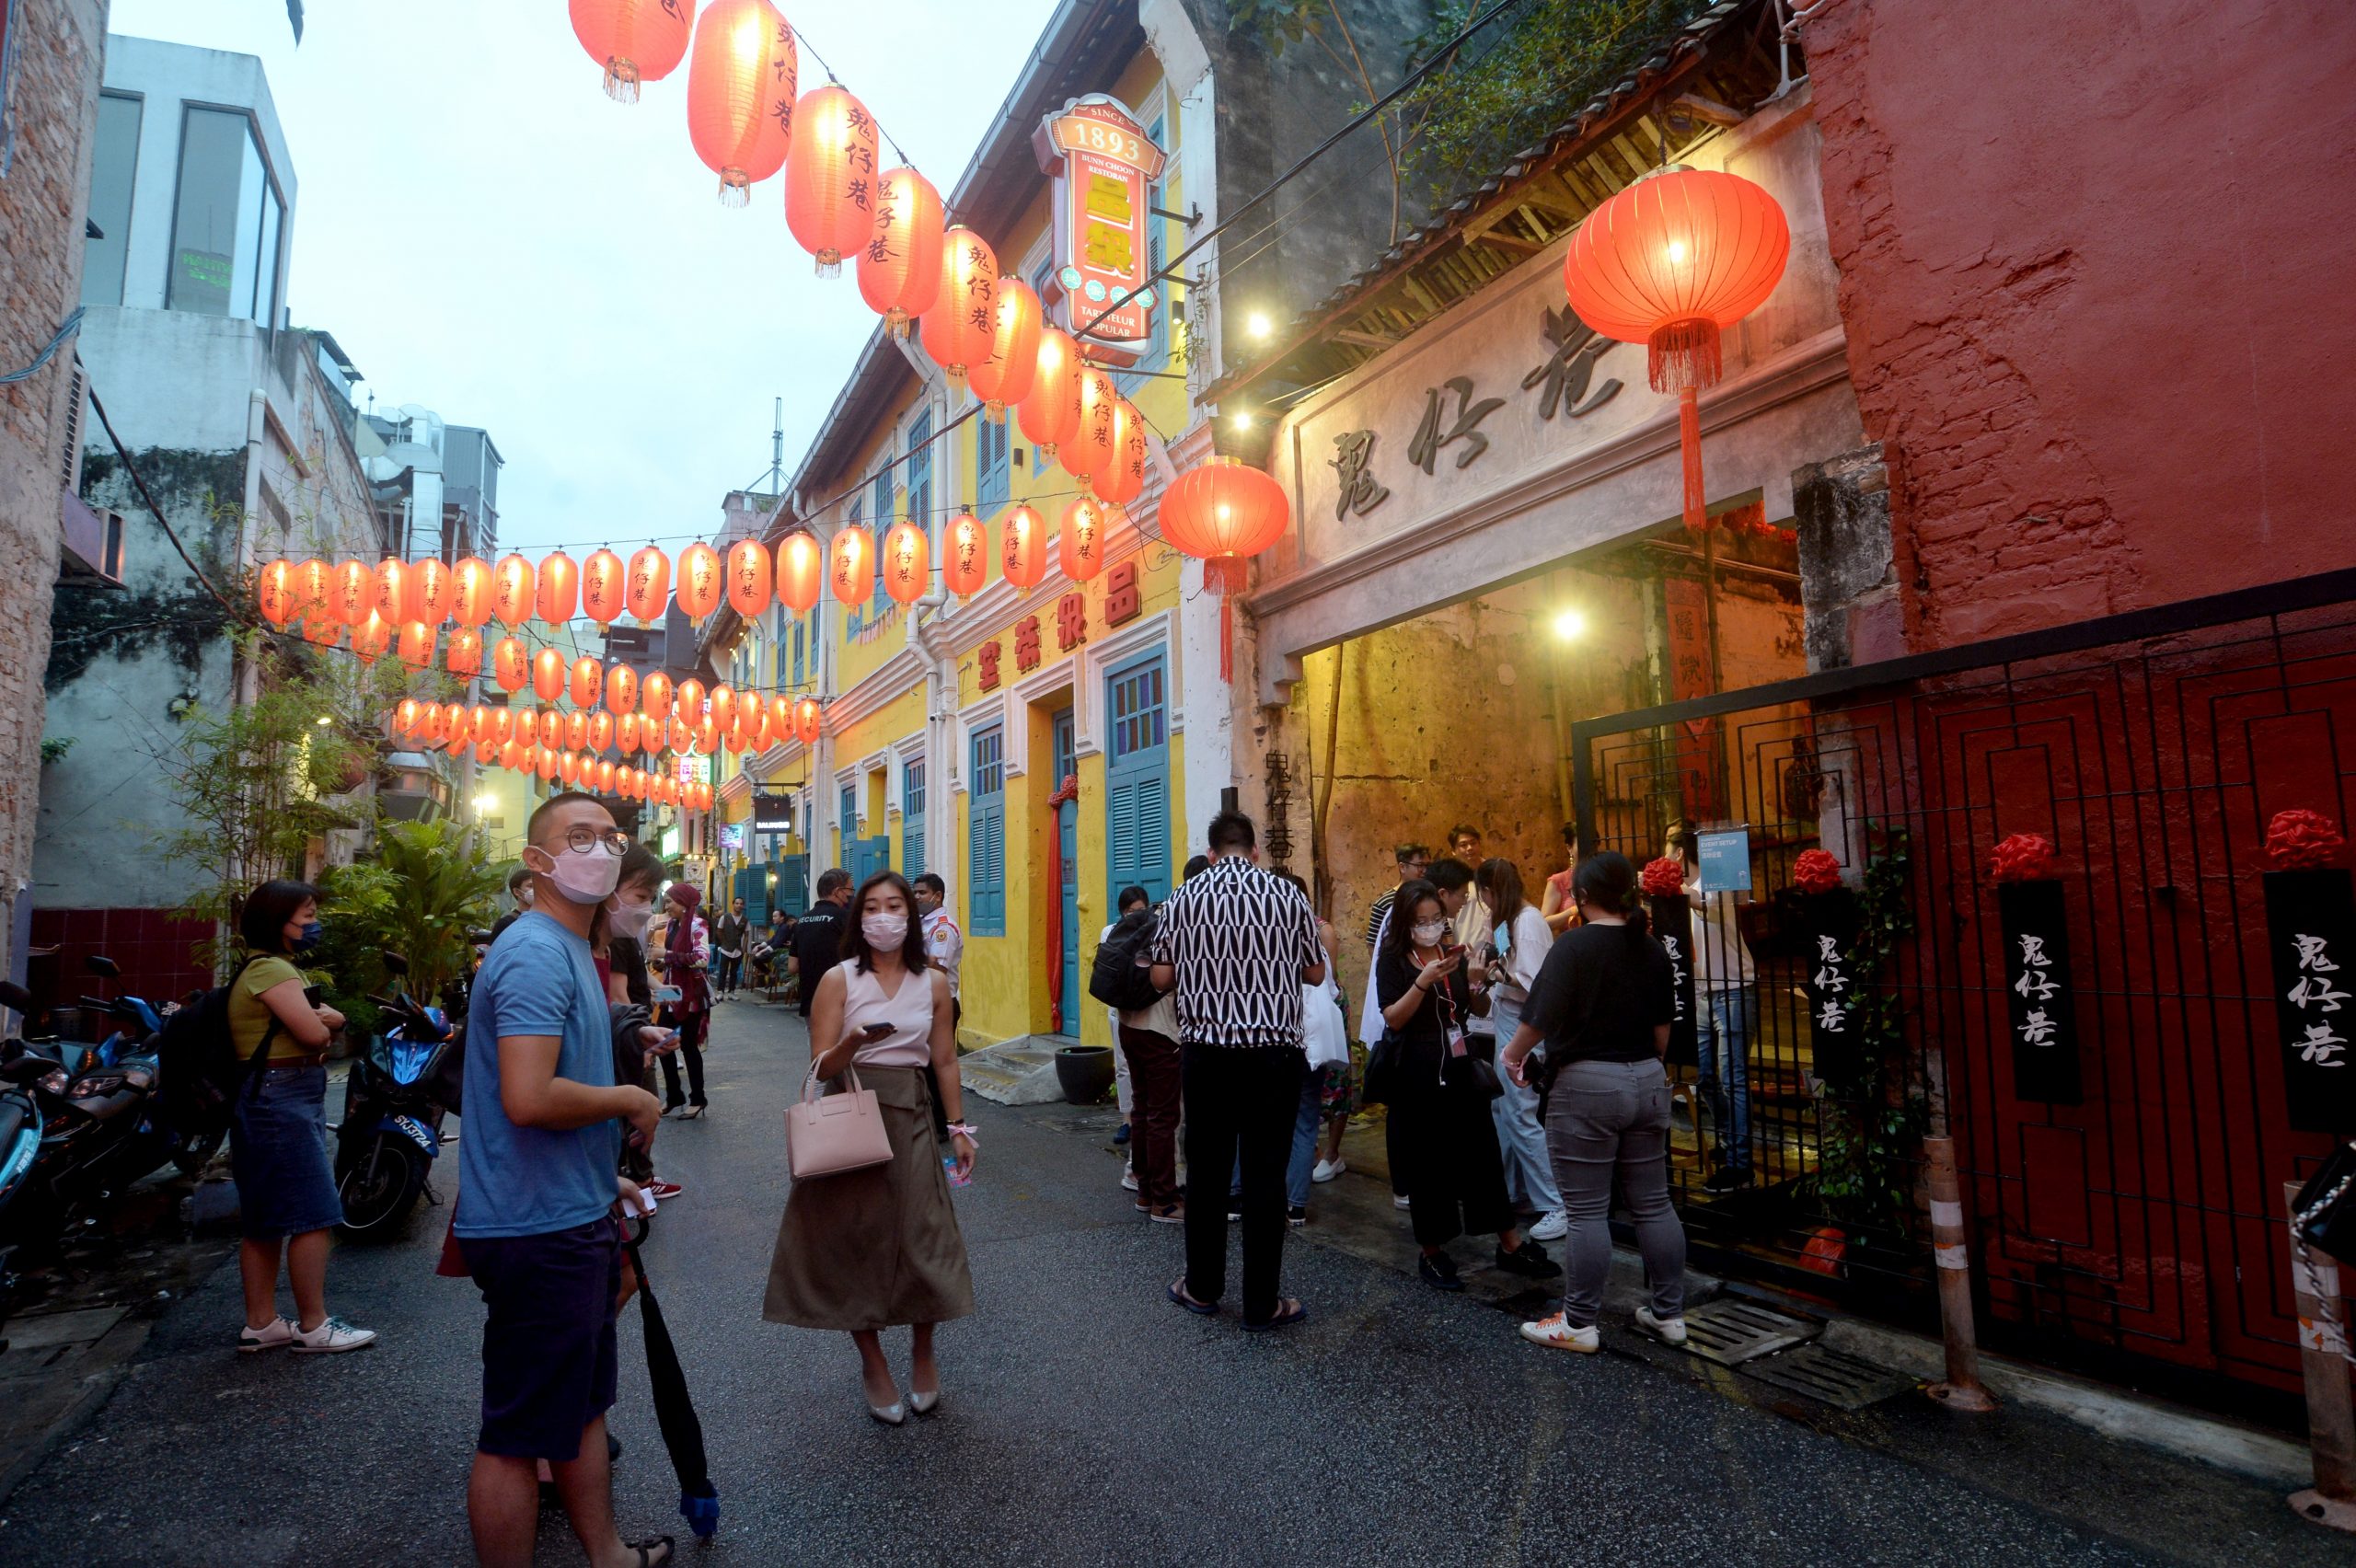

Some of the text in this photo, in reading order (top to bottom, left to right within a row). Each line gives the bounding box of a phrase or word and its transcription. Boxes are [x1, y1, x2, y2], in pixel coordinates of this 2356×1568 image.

[1091, 108, 1126, 125] SINCE
[845, 107, 873, 213] 鬼仔巷
[1075, 122, 1139, 161] 1893
[1081, 154, 1135, 176] BUNN CHOON
[1088, 165, 1128, 183] RESTORAN
[967, 246, 993, 334] 鬼仔巷
[1092, 379, 1112, 447] 鬼仔巷
[1129, 414, 1143, 478] 鬼仔巷
[894, 534, 915, 582] 鬼仔巷
[958, 525, 978, 574] 鬼仔巷
[1005, 520, 1023, 569] 鬼仔巷
[1077, 509, 1096, 559] 鬼仔巷
[738, 551, 758, 597] 鬼仔巷
[837, 537, 855, 587] 鬼仔巷
[1265, 750, 1295, 859] 鬼仔巷
[798, 915, 834, 925] SECURITY
[1814, 934, 1850, 1032] 鬼仔巷
[2015, 933, 2062, 1047] 鬼仔巷
[2288, 933, 2352, 1068] 鬼仔巷
[394, 1114, 432, 1148] SYJ3724
